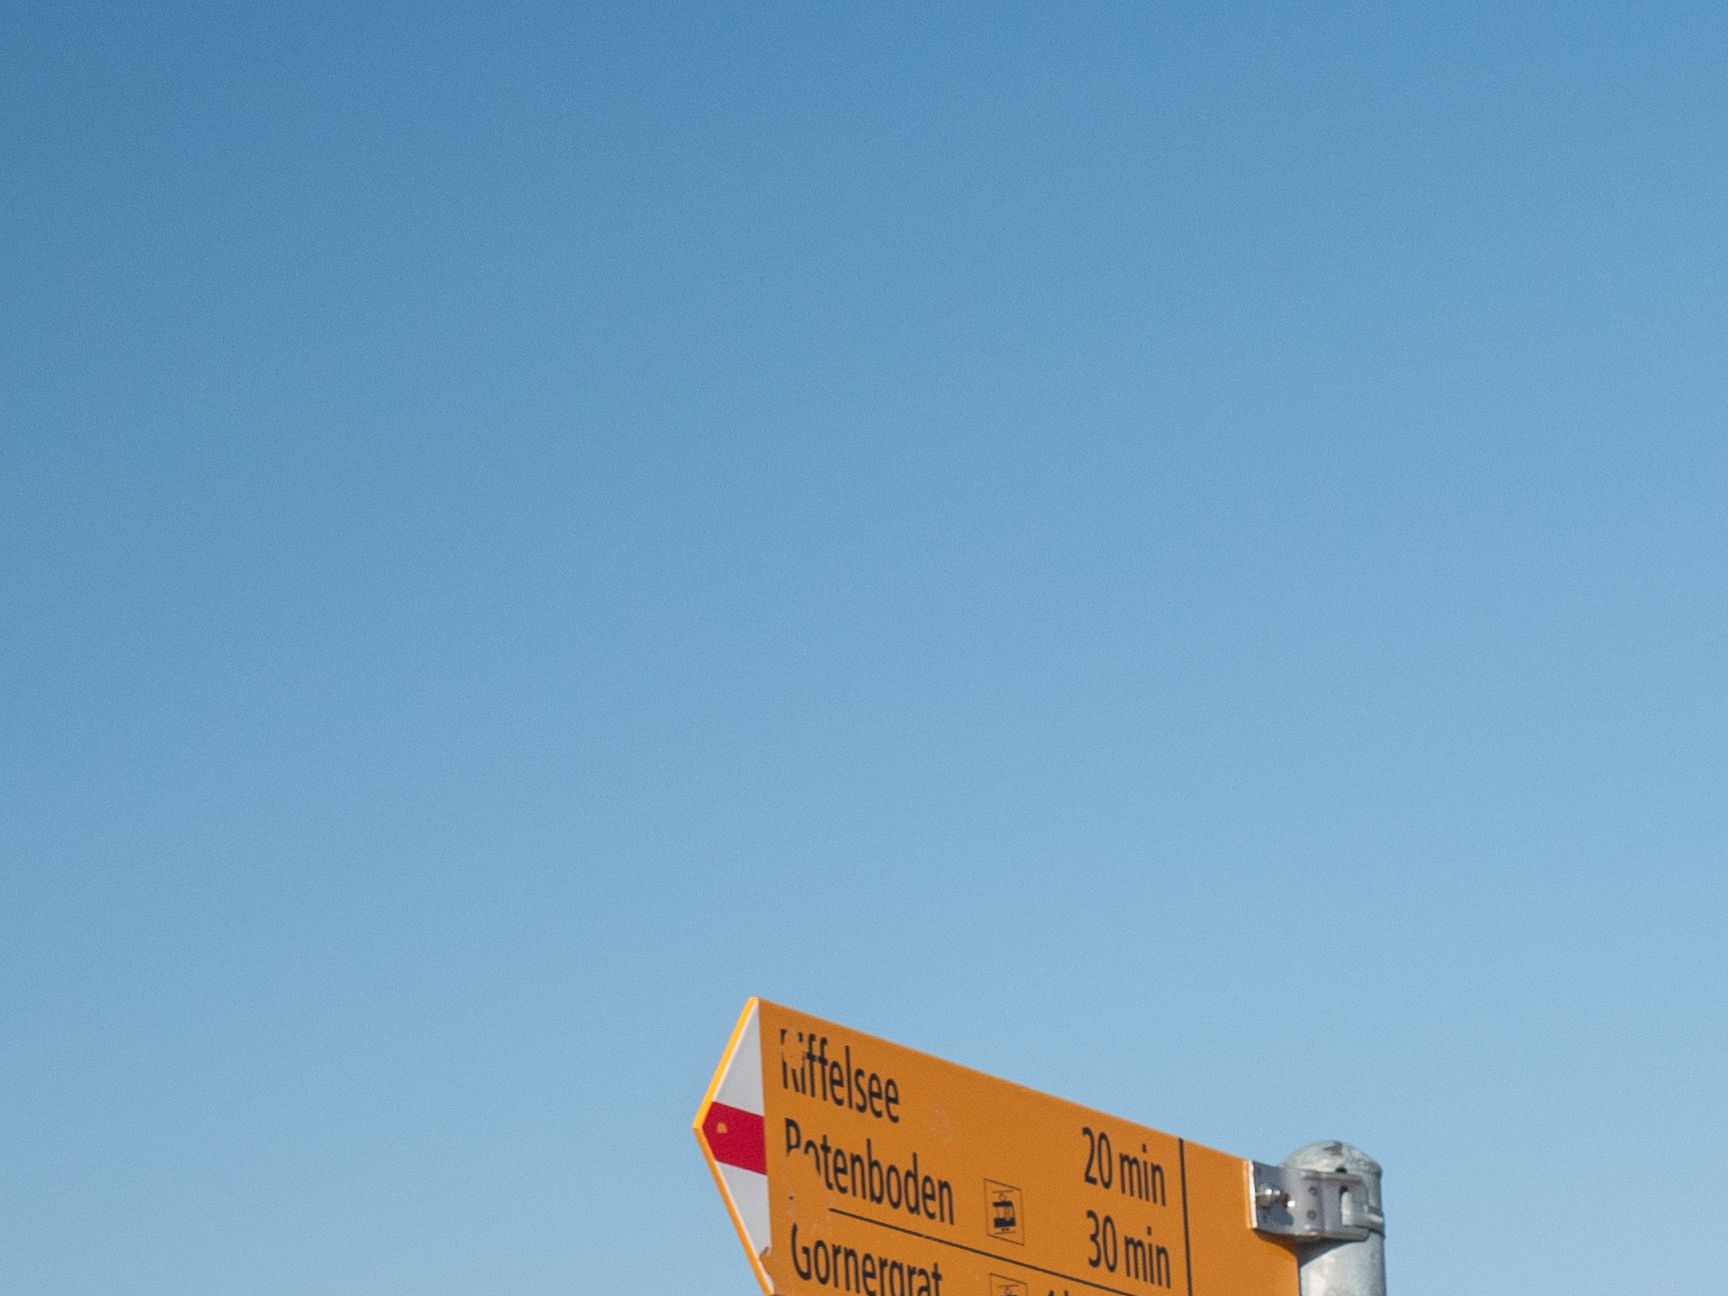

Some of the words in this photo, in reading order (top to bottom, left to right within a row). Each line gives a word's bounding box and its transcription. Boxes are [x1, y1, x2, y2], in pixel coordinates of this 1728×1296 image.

[1082, 1125, 1113, 1190] 20
[1119, 1143, 1167, 1207] min
[1086, 1209, 1118, 1274] 30
[1124, 1225, 1172, 1290] min
